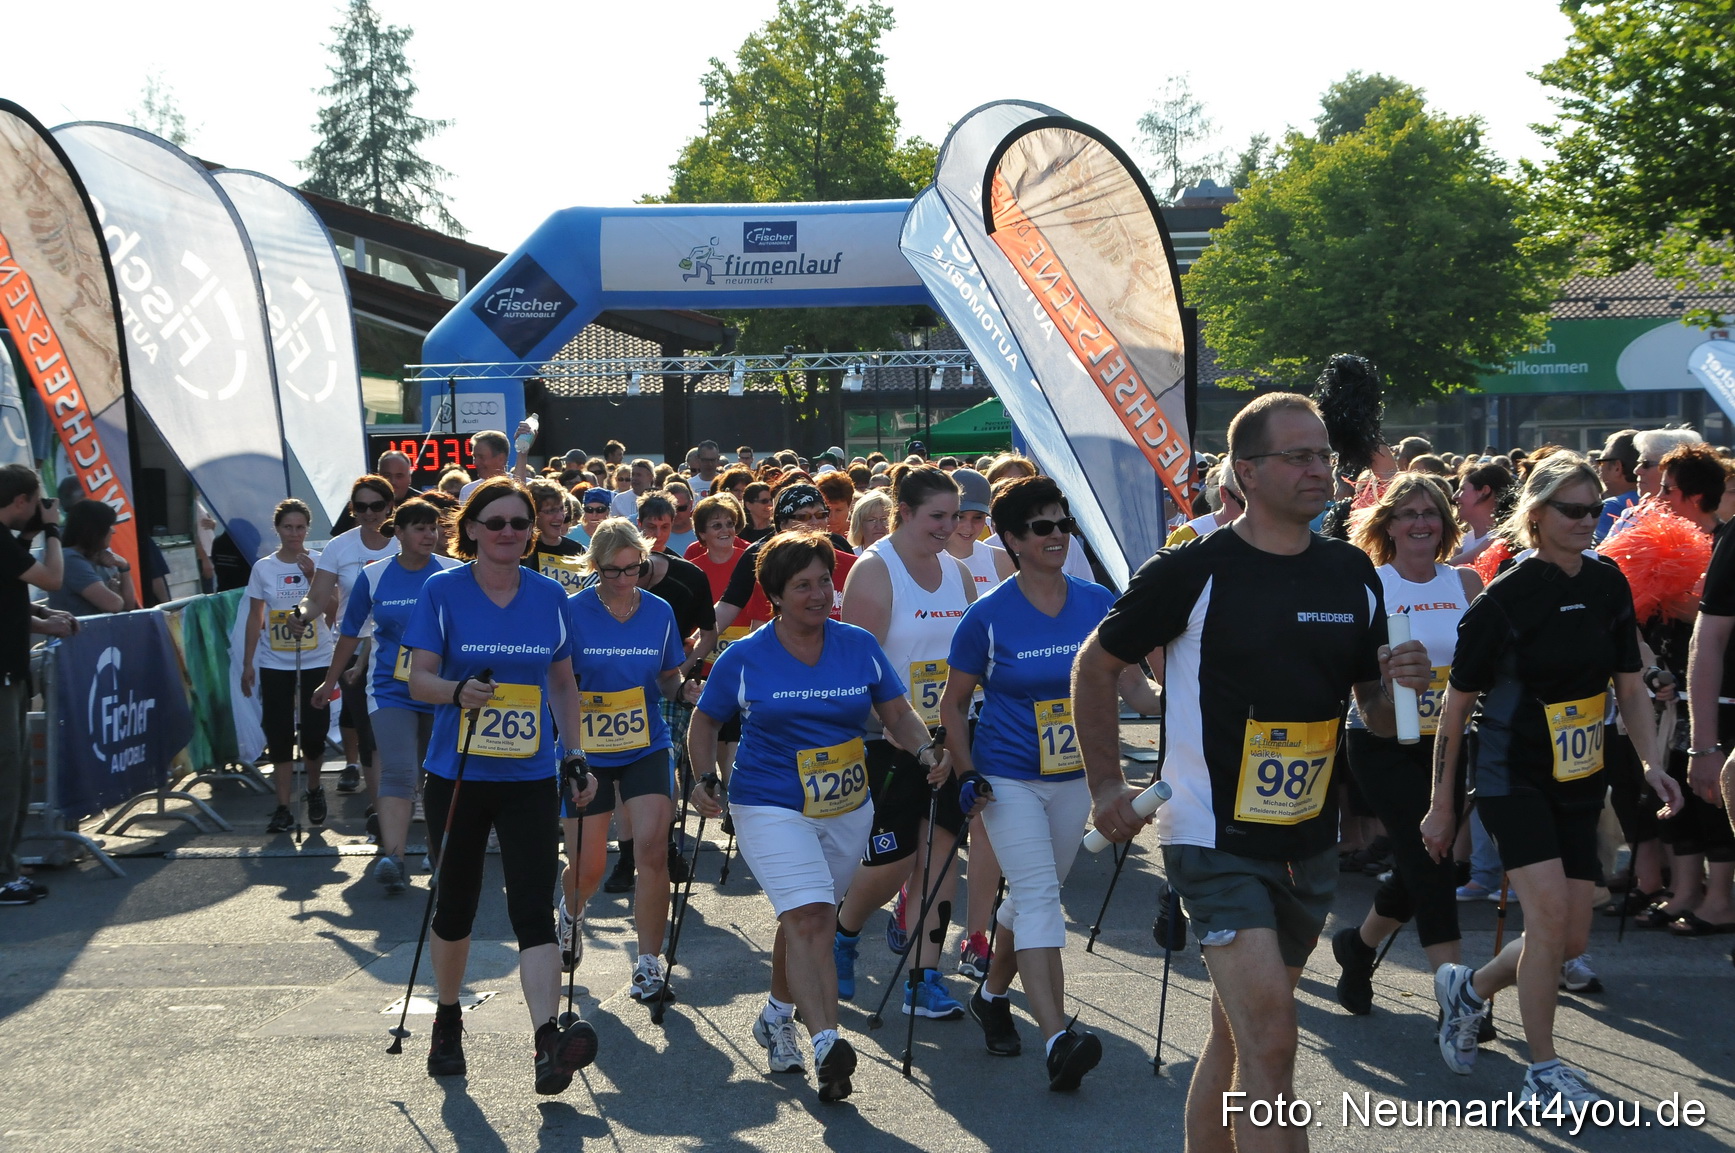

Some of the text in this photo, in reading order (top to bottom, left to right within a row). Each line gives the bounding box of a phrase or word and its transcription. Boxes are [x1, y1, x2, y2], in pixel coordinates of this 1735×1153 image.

[755, 233, 793, 241] Fischer
[724, 252, 842, 276] firmenlauf
[725, 276, 774, 284] neumarkt
[497, 297, 562, 311] Fischer
[541, 566, 581, 588] 1134
[1414, 602, 1461, 612] KLEBL
[1306, 612, 1354, 623] PFLEIDERER
[461, 642, 551, 655] energiegeladen
[583, 646, 659, 657] energiegeladen
[772, 684, 869, 699] energiegeladen
[581, 708, 645, 738] 1265
[1041, 724, 1077, 756] 12
[1555, 720, 1603, 762] 1070
[1250, 749, 1283, 759] walken
[805, 763, 866, 803] 1269
[1255, 756, 1328, 800] 987
[1263, 799, 1288, 807] Michael
[1249, 806, 1277, 815] Pfleiderer
